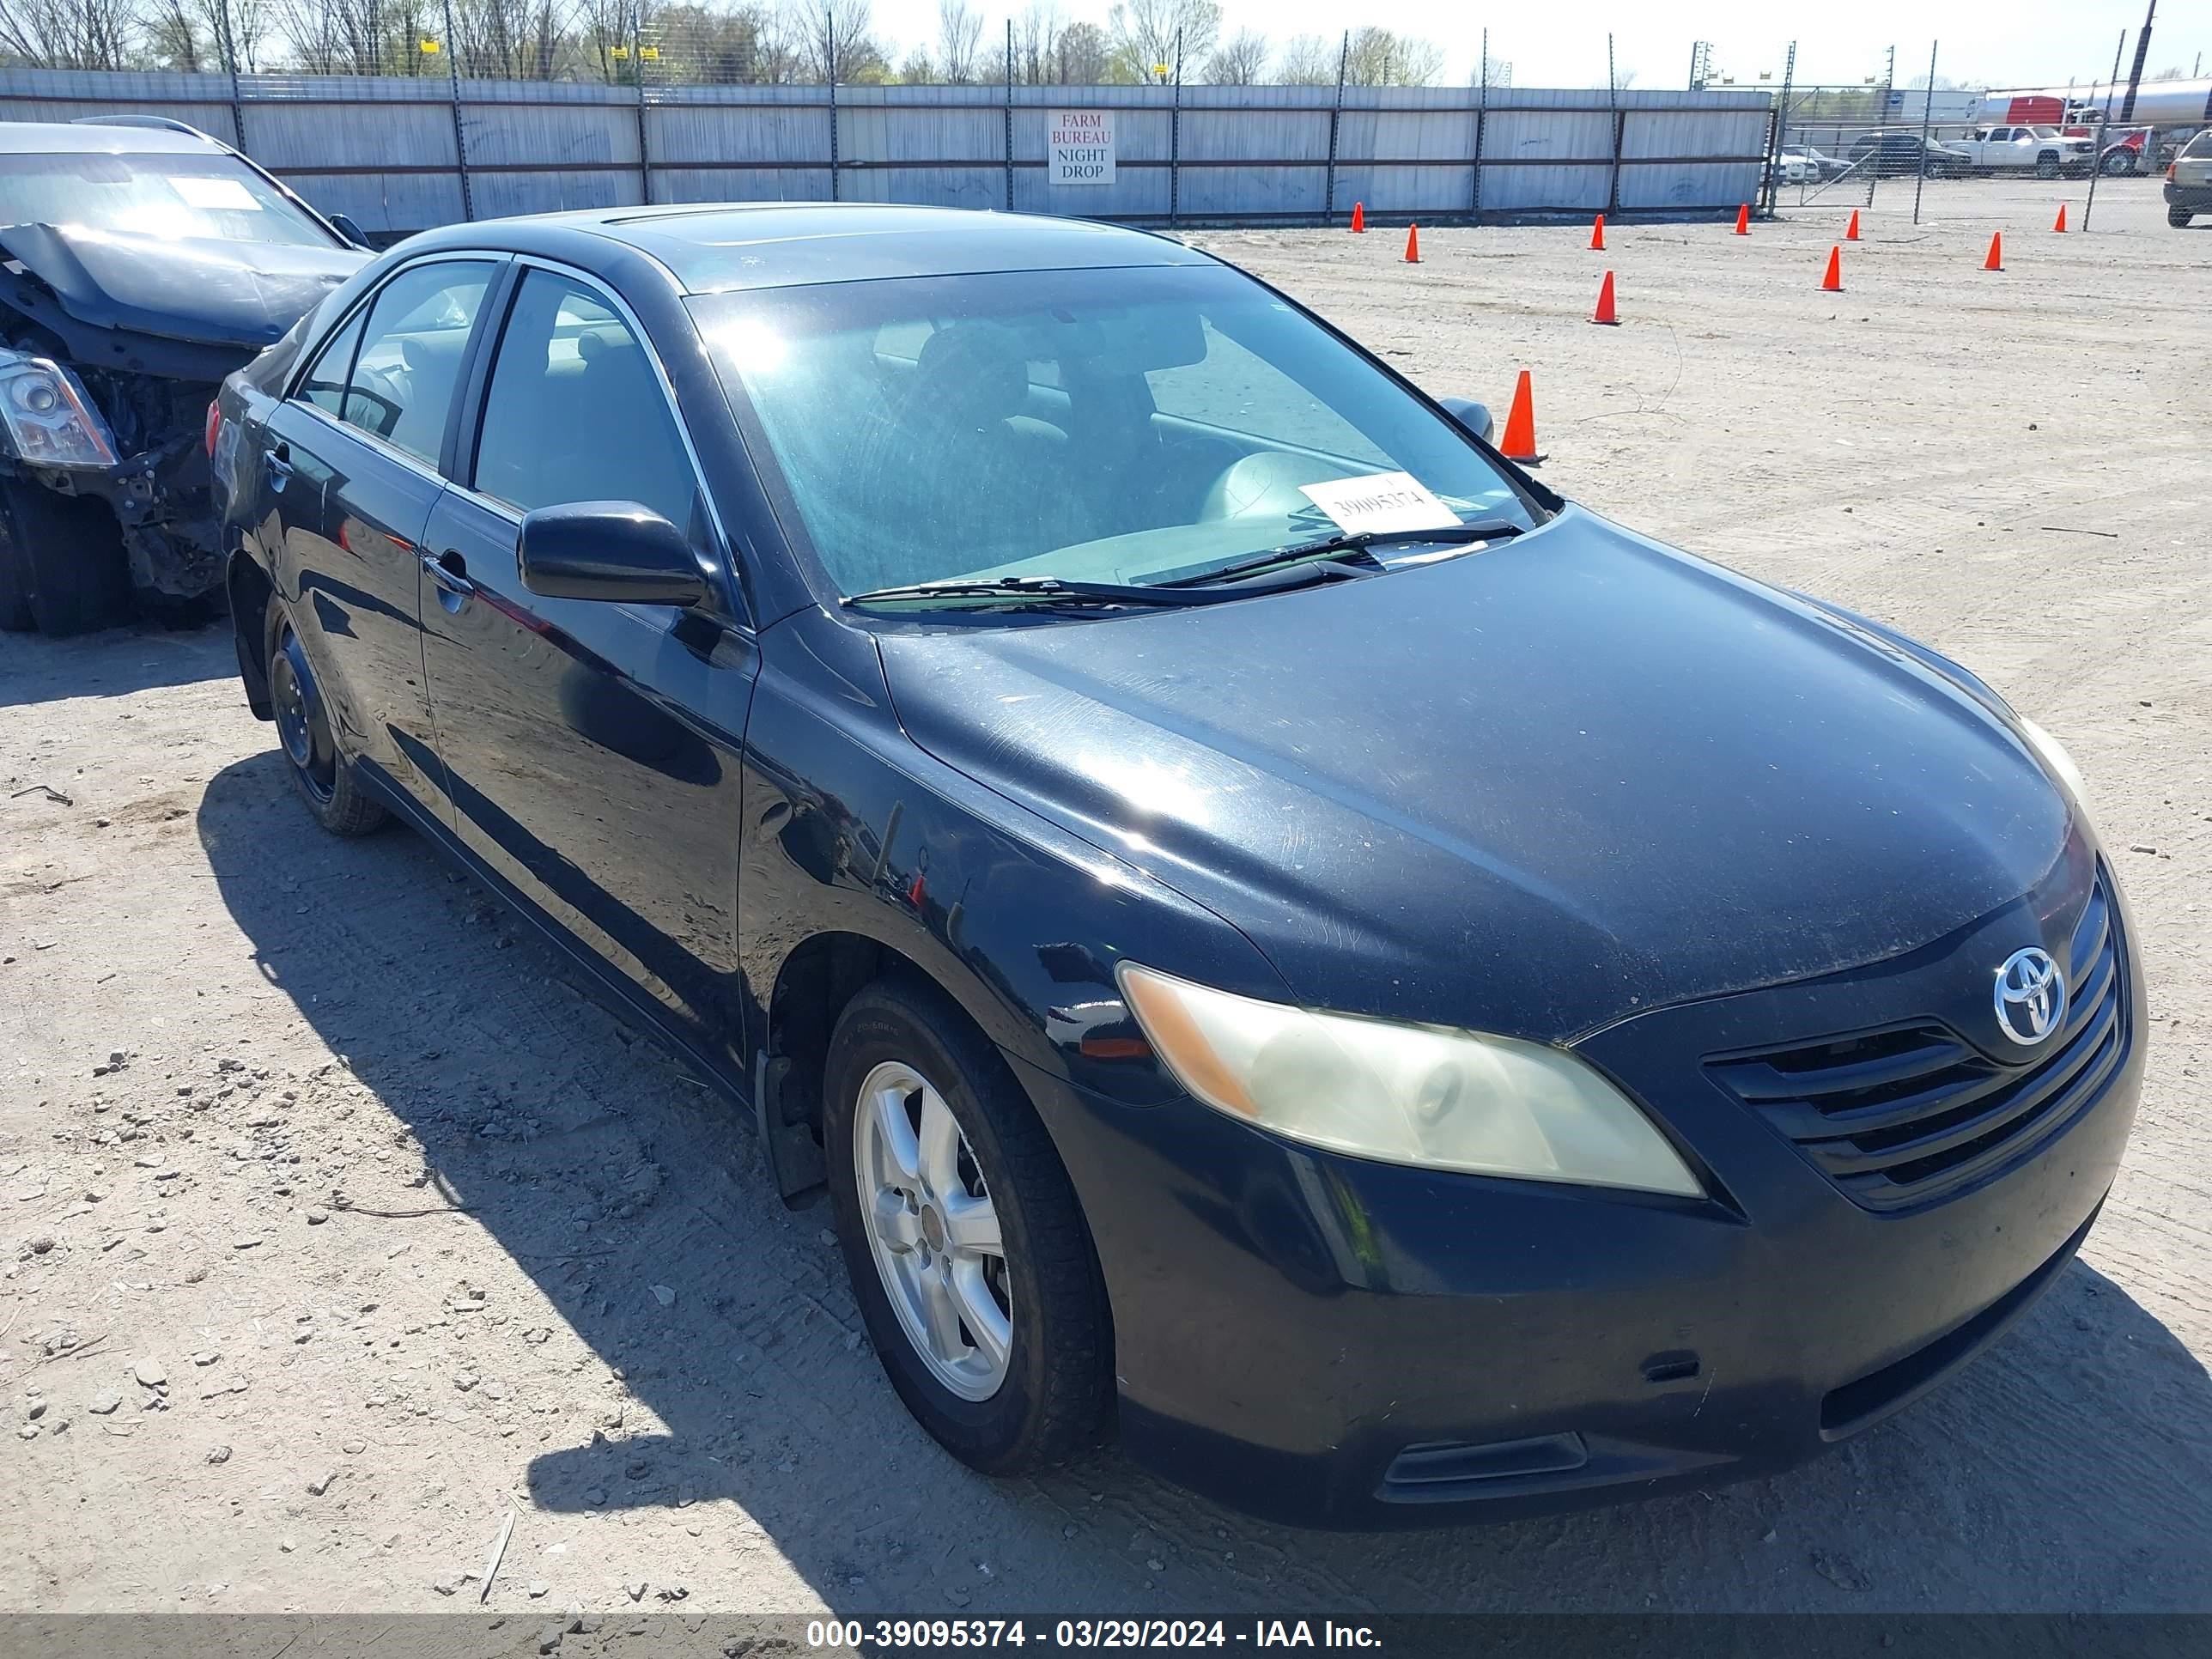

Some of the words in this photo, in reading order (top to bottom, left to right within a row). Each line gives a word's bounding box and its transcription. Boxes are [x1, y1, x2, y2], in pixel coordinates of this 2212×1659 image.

[1062, 114, 1101, 127] FARM
[1053, 131, 1111, 143] BUREAU
[1058, 149, 1107, 161] NIGHT
[1062, 166, 1103, 178] DROP
[1334, 490, 1425, 516] 39095374
